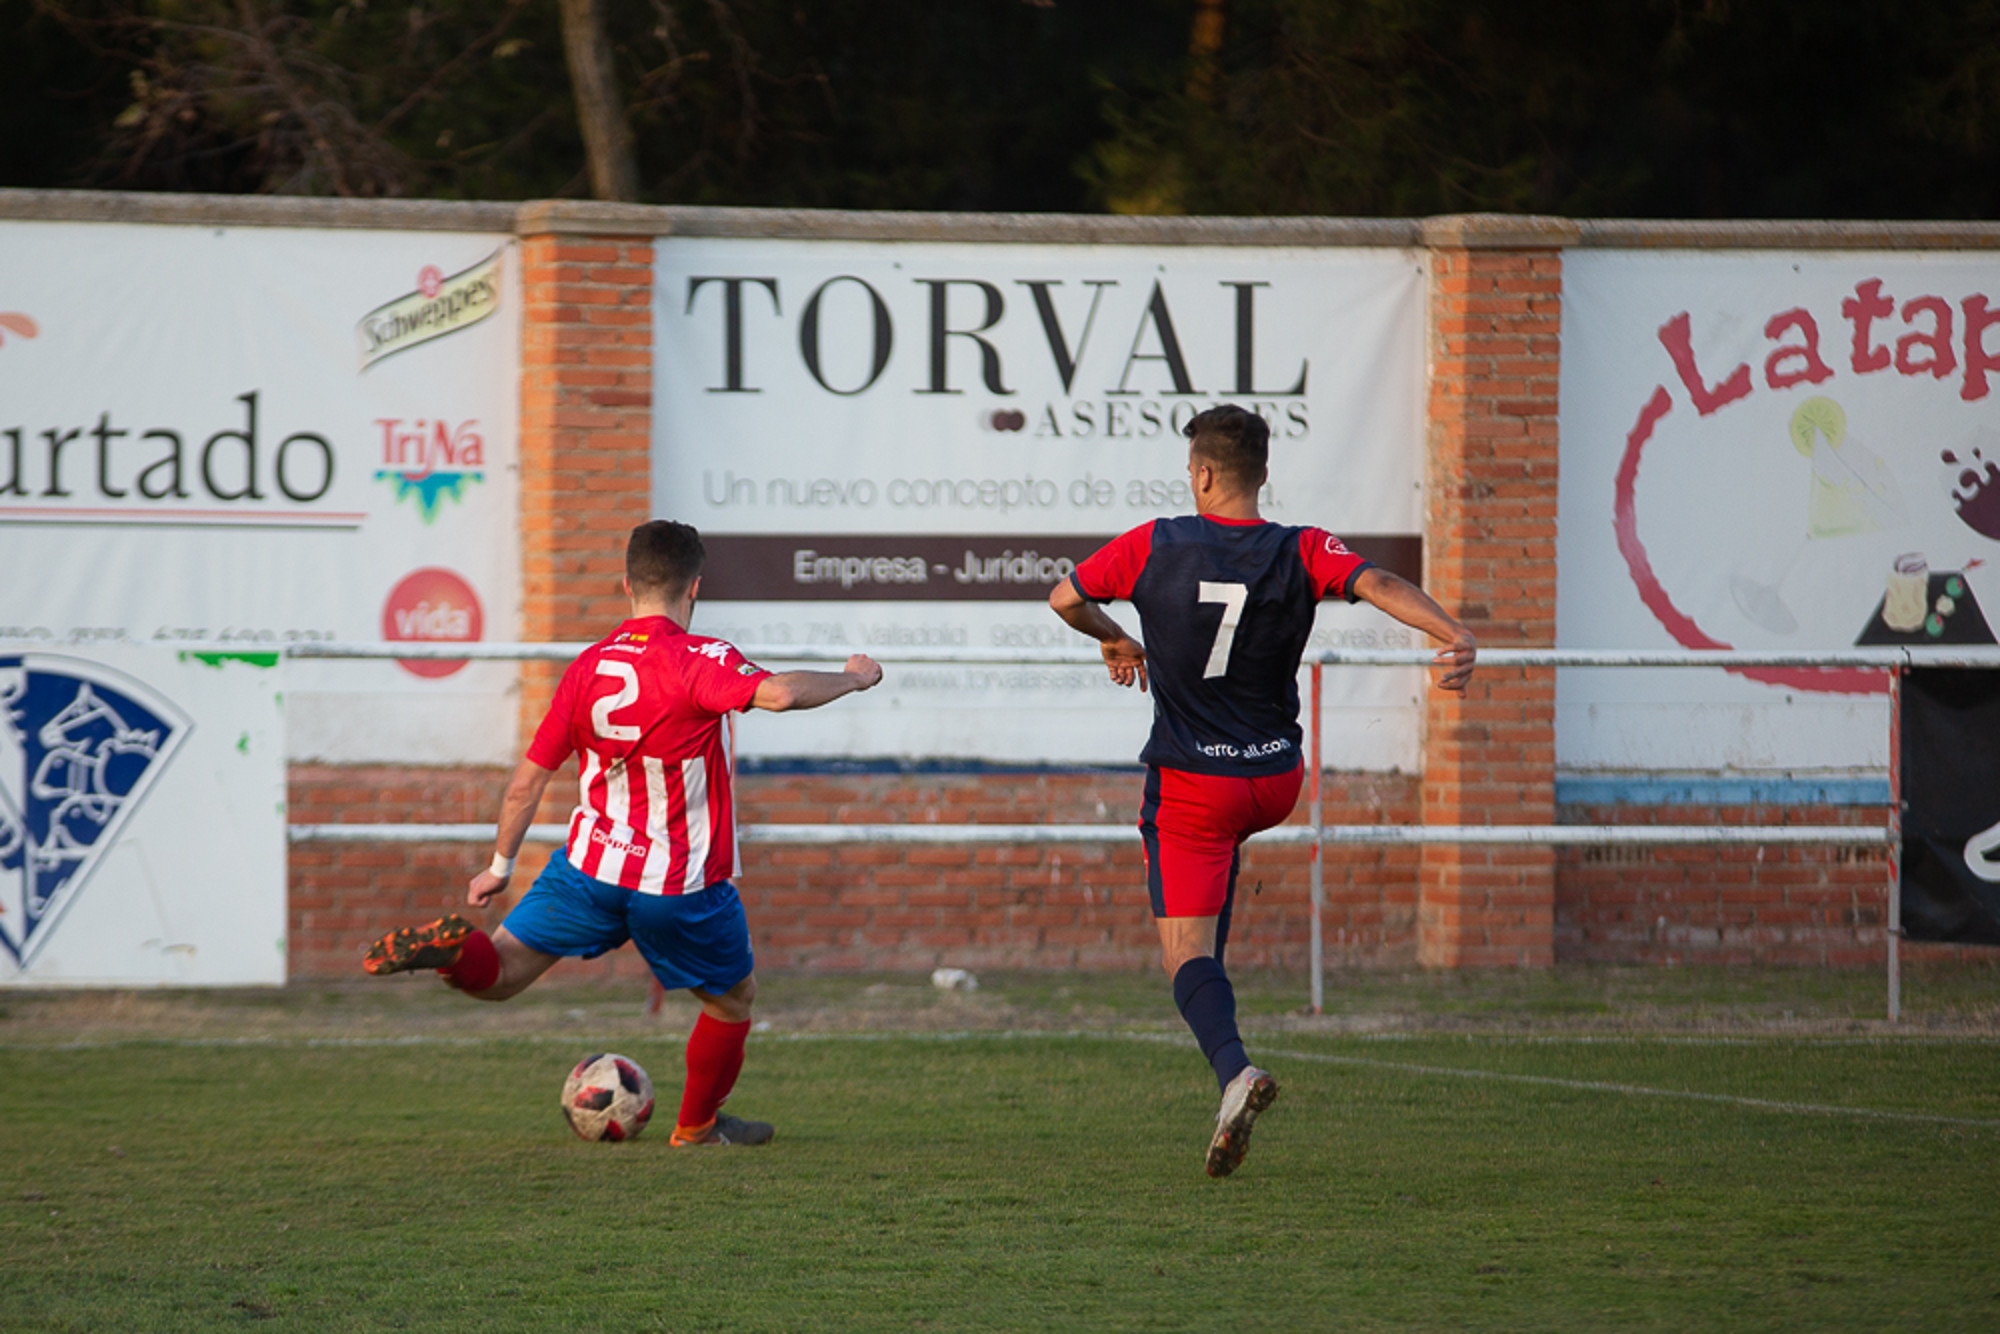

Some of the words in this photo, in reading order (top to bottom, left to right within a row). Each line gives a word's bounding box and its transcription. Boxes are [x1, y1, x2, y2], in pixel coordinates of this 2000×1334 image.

[363, 272, 496, 352] Schweppes
[684, 275, 1309, 396] TORVAL
[1034, 401, 1310, 438] ASESOES
[703, 471, 757, 506] Un
[767, 478, 878, 507] nuevo
[887, 474, 1059, 513] concepto
[1068, 473, 1115, 507] de
[793, 550, 929, 588] Empresa
[954, 550, 1075, 584] Jurídico
[396, 601, 472, 638] vida
[857, 622, 968, 647] Valladolid
[1199, 581, 1248, 679] 7
[592, 659, 641, 741] 2
